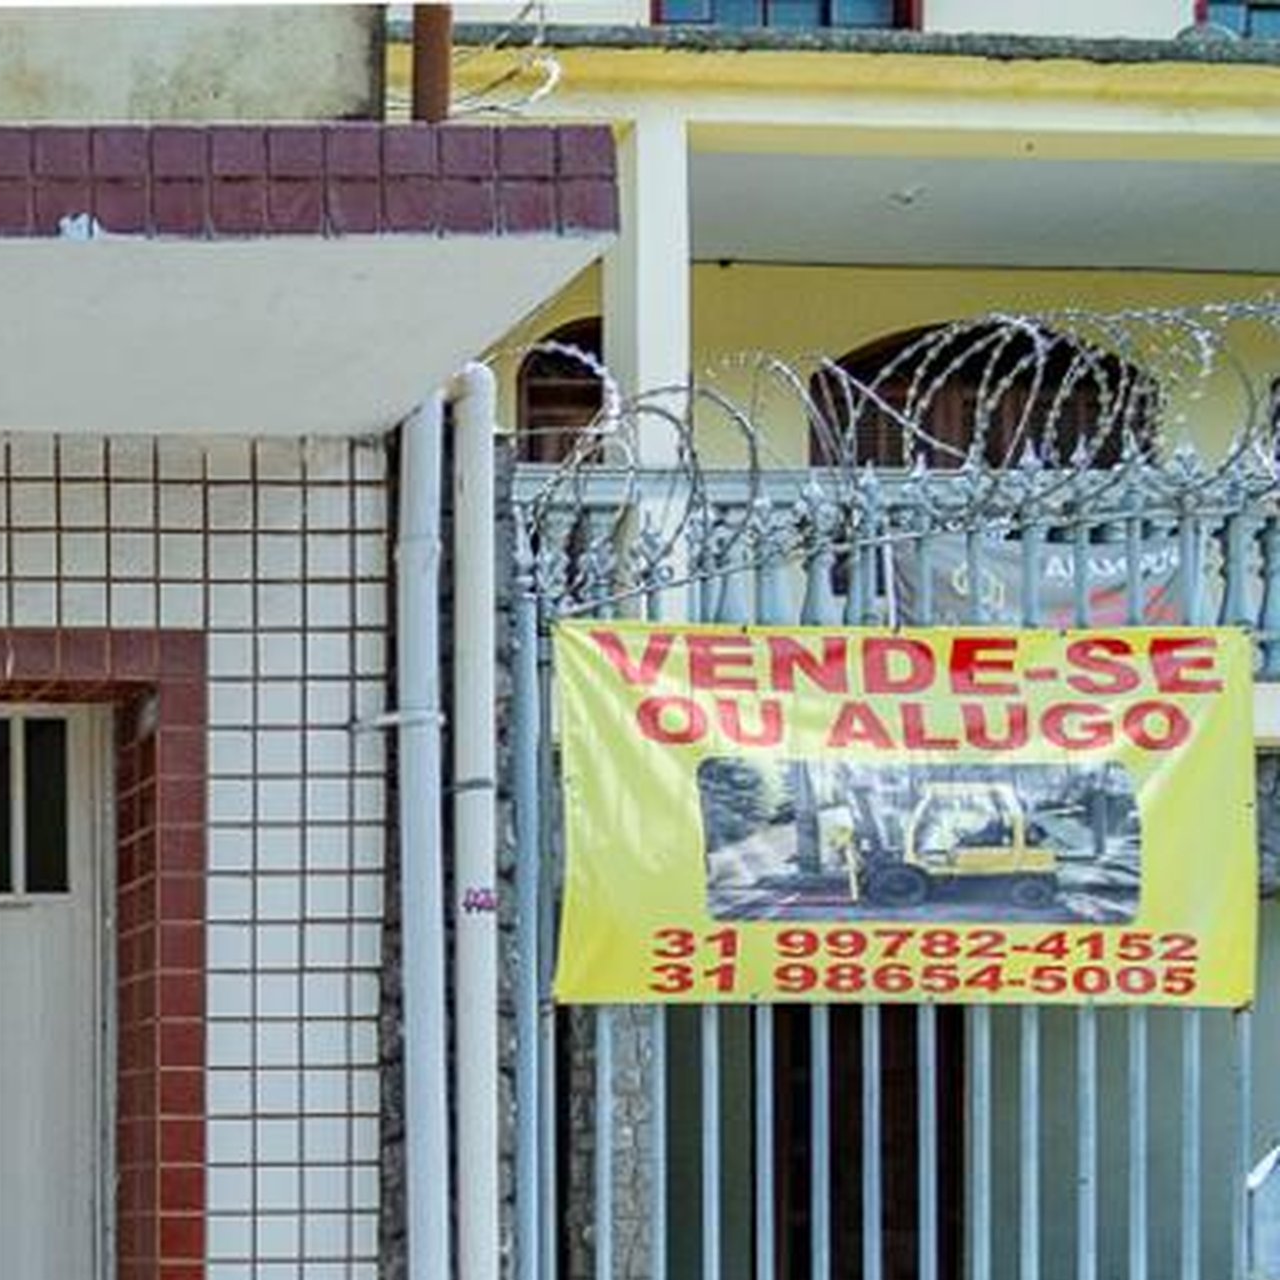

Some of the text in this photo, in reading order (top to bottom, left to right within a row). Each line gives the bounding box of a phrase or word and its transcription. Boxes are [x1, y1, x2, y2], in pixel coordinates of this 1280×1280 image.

[589, 631, 1224, 695] VENDE-SE
[639, 697, 1193, 752] OU ALUGO
[652, 929, 1199, 962] 31 99782-4152
[649, 964, 1198, 997] 31 98654-5005
